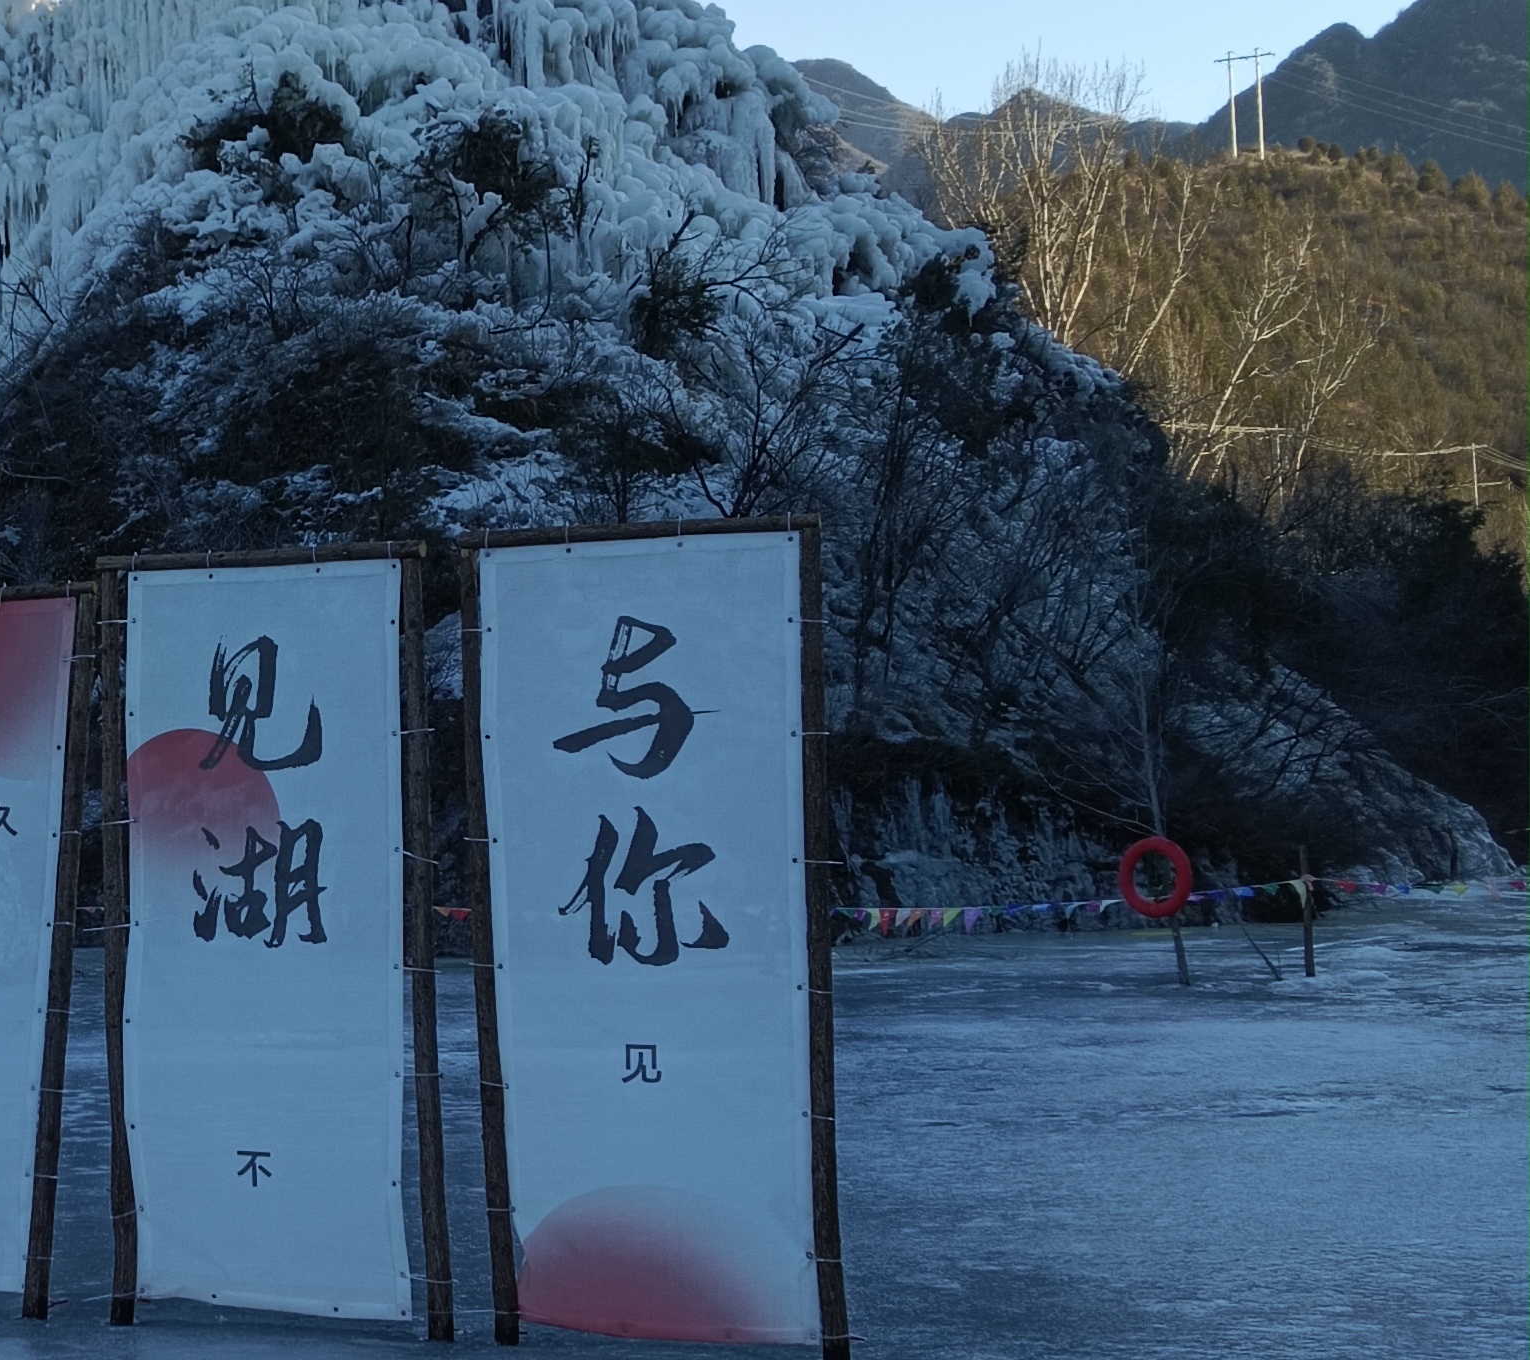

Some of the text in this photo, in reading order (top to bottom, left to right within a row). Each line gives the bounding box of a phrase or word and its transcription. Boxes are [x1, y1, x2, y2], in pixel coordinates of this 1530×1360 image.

[192, 635, 328, 948] 见湖
[553, 616, 730, 966] 与你
[622, 1043, 663, 1084] 见
[236, 1150, 273, 1188] 不
